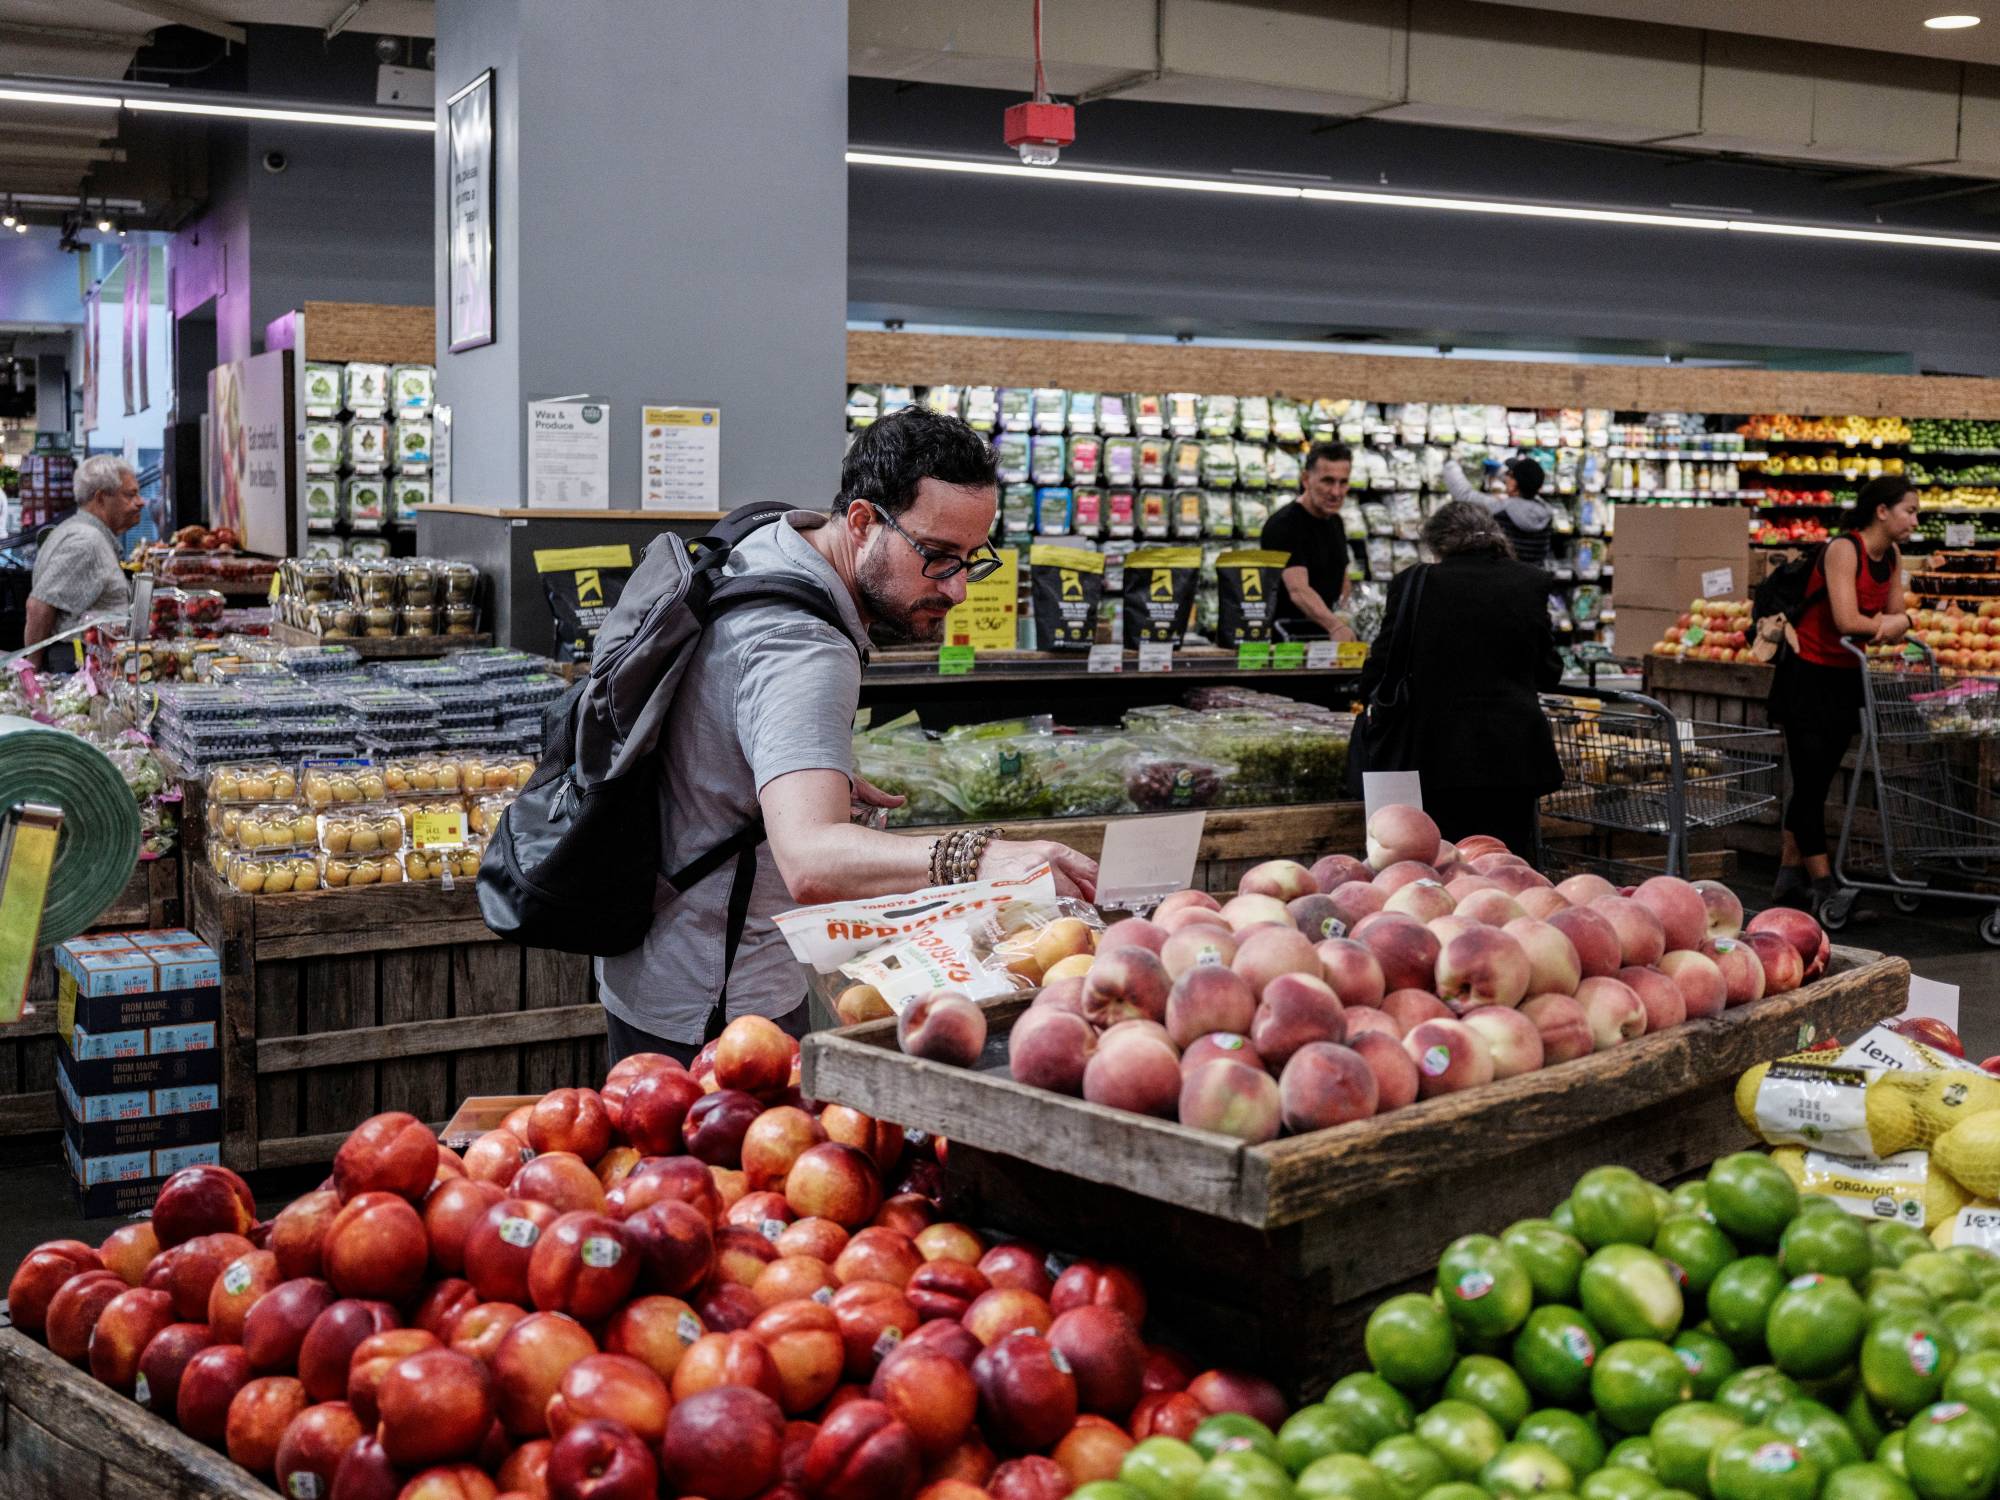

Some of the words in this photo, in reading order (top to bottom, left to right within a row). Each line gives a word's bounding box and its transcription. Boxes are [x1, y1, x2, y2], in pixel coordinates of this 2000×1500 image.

[536, 410, 556, 419] Wax
[559, 410, 565, 419] &
[536, 420, 574, 430] Produce
[193, 979, 217, 988] SURF
[124, 985, 147, 994] SURF
[121, 1001, 142, 1013] FROM
[121, 1013, 140, 1024] WITH
[185, 1041, 208, 1051] SURF
[115, 1048, 137, 1057] SURF
[113, 1063, 134, 1073] FROM
[113, 1074, 132, 1085] WITH
[188, 1101, 211, 1111] SURF
[119, 1108, 143, 1118] SURF
[114, 1123, 134, 1135] FROM
[115, 1134, 134, 1145] WITH
[120, 1168, 144, 1179] SURF
[116, 1187, 138, 1199] FROM
[1833, 1181, 1896, 1196] ORGANIC
[116, 1198, 138, 1210] WITH
